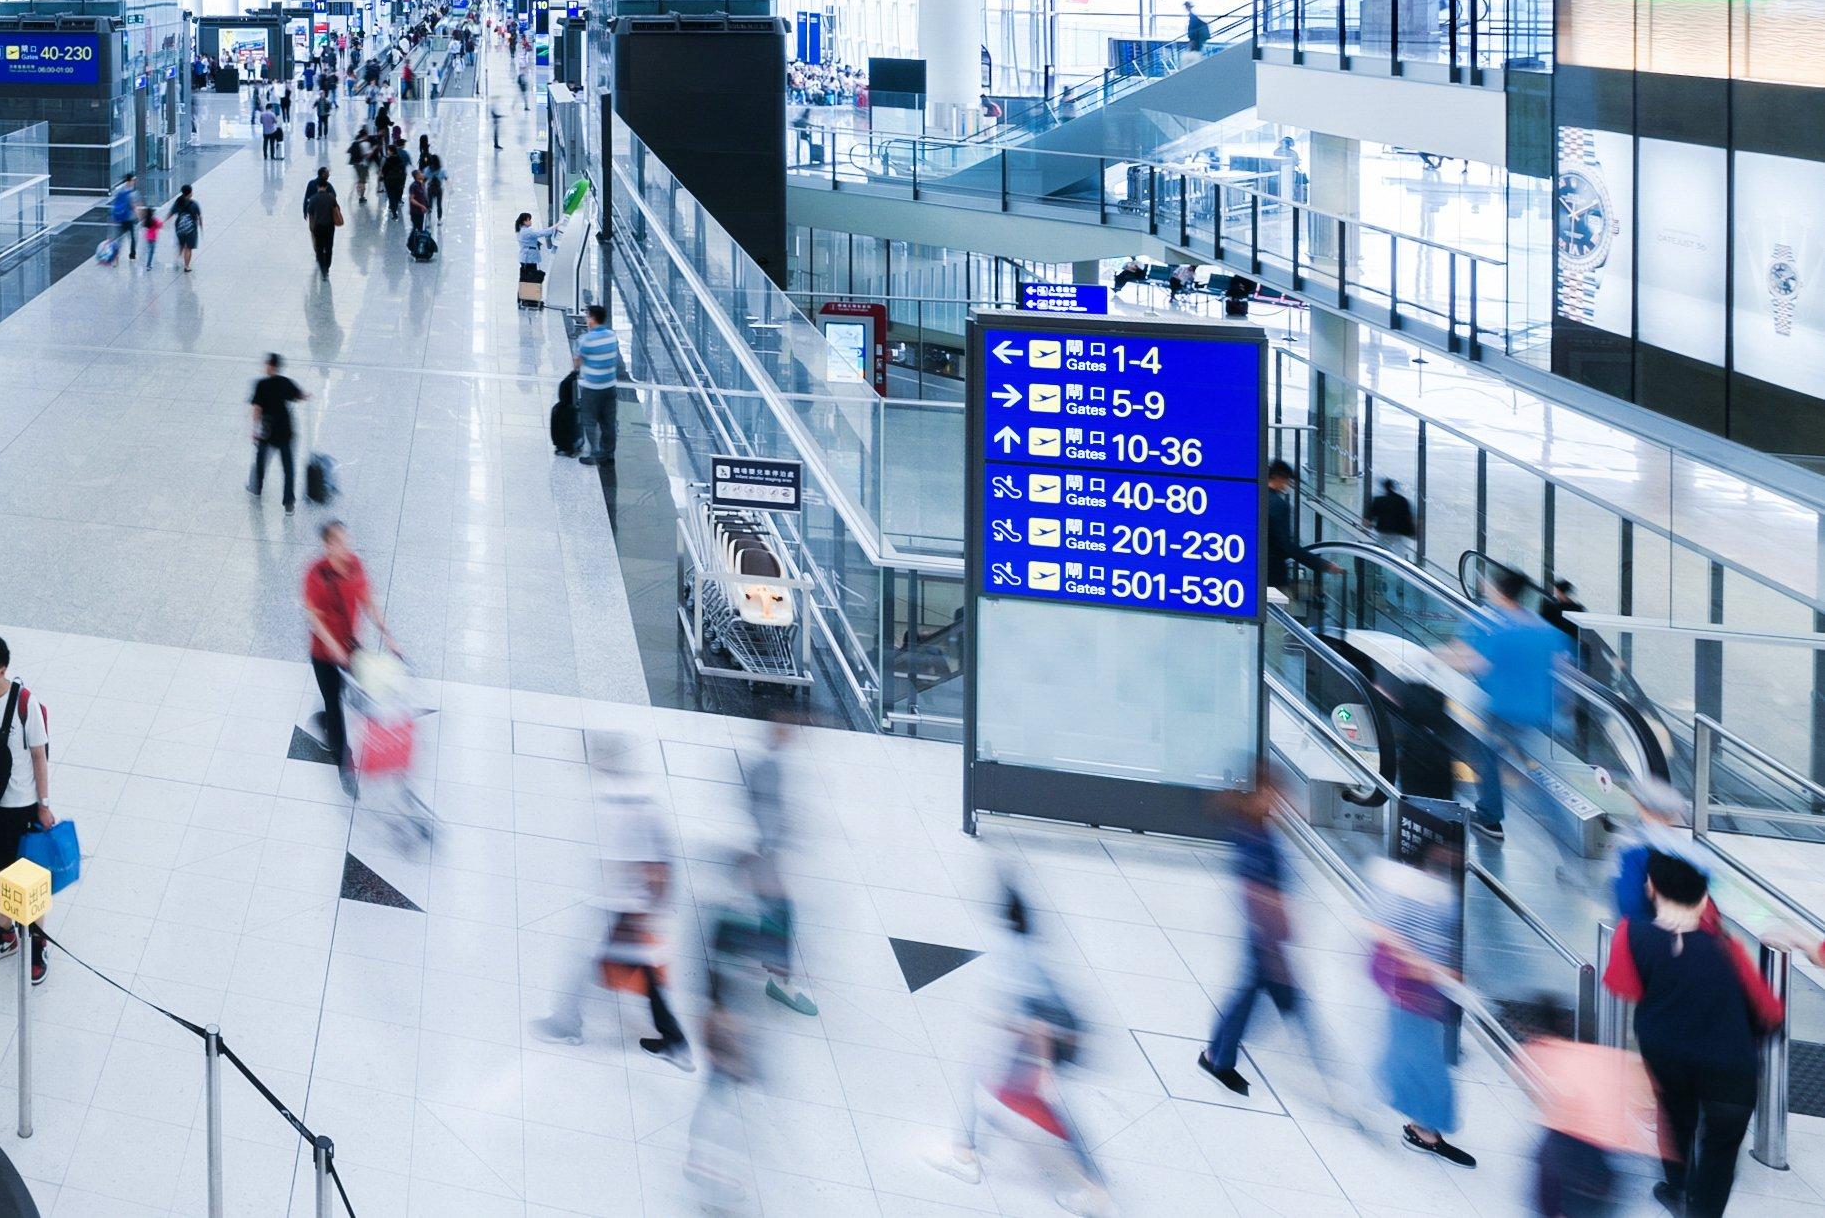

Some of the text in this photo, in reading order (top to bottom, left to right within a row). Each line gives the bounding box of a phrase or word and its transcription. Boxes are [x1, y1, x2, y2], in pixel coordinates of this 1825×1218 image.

[316, 2, 325, 11] 11
[537, 1, 548, 10] 10
[40, 46, 93, 61] 40-230
[1065, 344, 1163, 375] Gates 1-4
[1065, 389, 1165, 419] Gates 5-9
[1065, 433, 1203, 467] Gates 10-36
[1065, 481, 1208, 516] Gates 40-80
[1065, 525, 1245, 563] Gates 201-230
[1065, 569, 1245, 609] Gates 501-530
[1, 882, 23, 905] 出口
[29, 881, 48, 905] 出口
[3, 900, 19, 917] Out
[31, 900, 45, 916] Out
